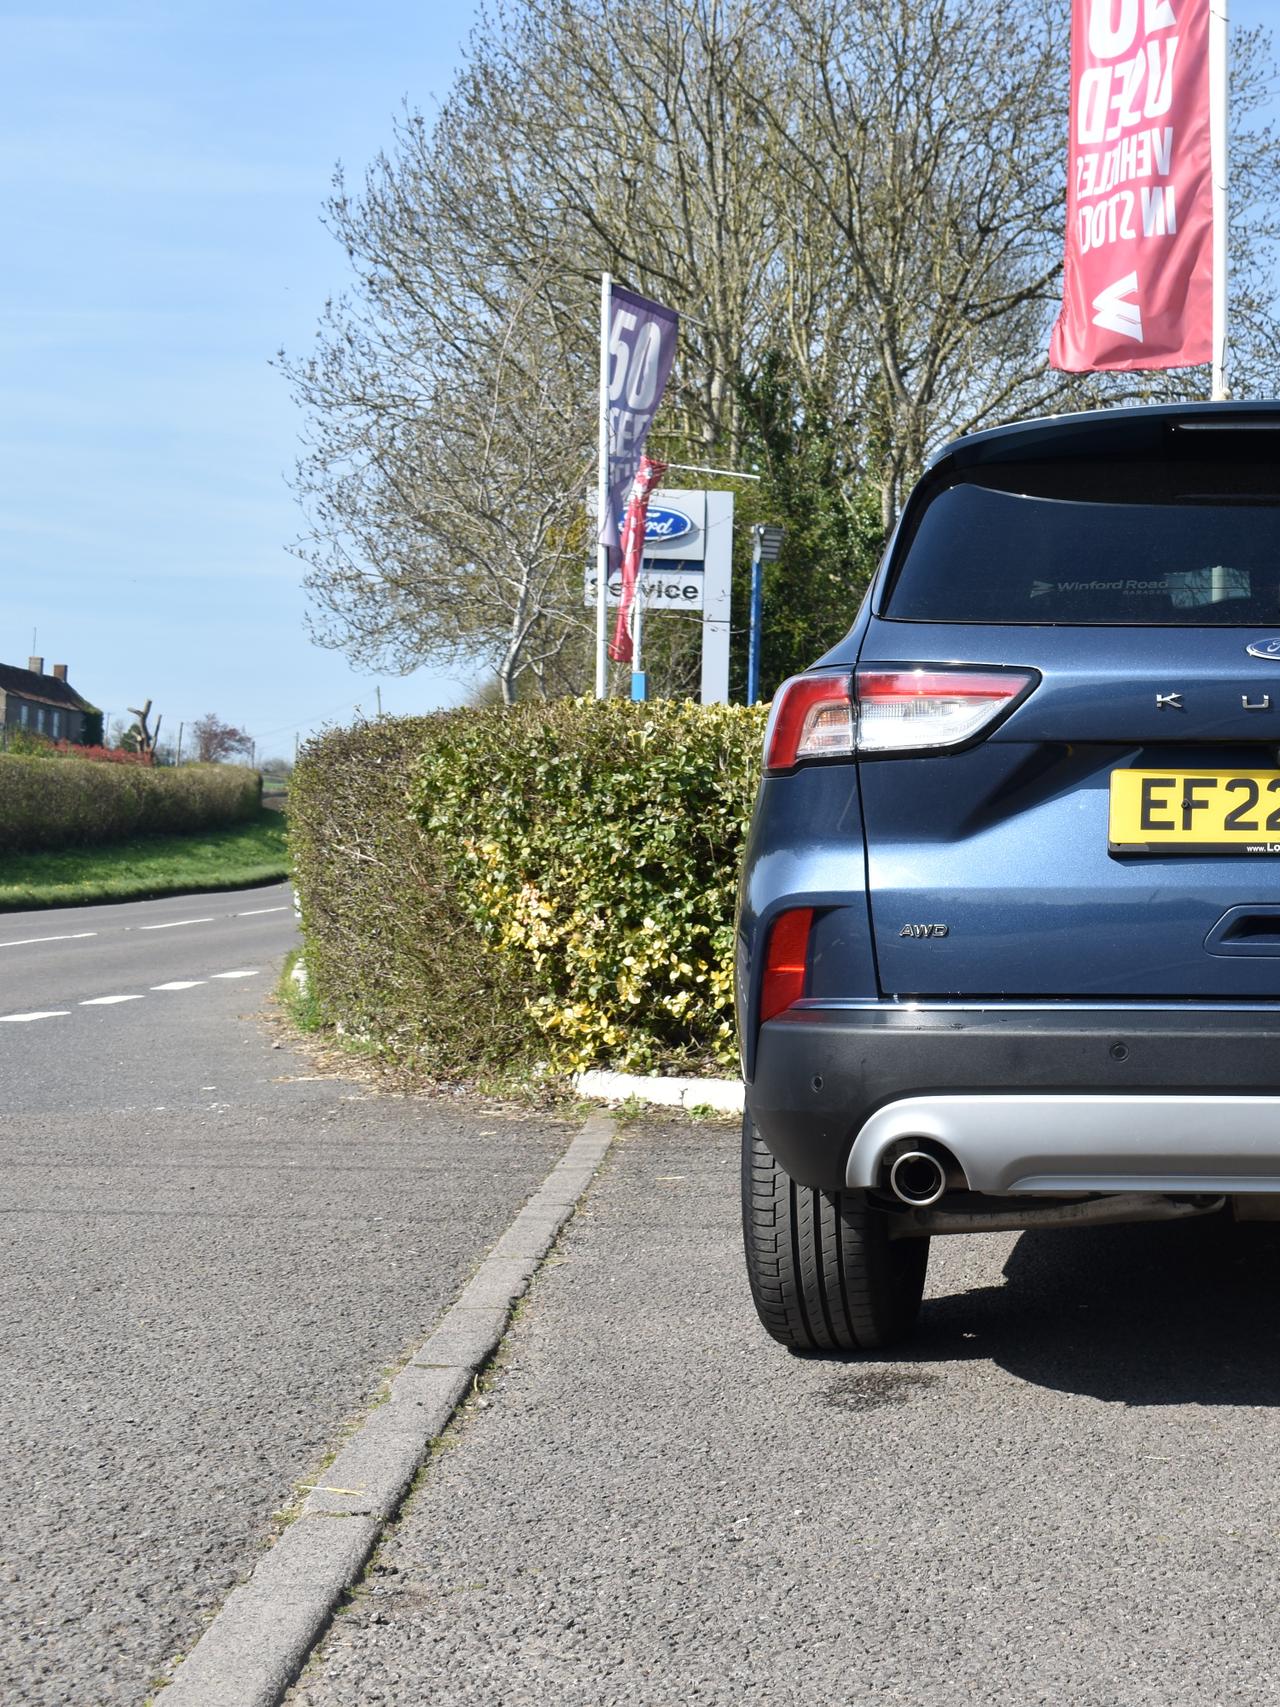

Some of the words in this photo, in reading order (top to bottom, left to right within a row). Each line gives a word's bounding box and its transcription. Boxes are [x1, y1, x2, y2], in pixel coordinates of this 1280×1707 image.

[608, 308, 661, 411] 50
[1057, 580, 1123, 591] Winford
[1126, 580, 1169, 589] Road
[899, 923, 948, 937] AWD
